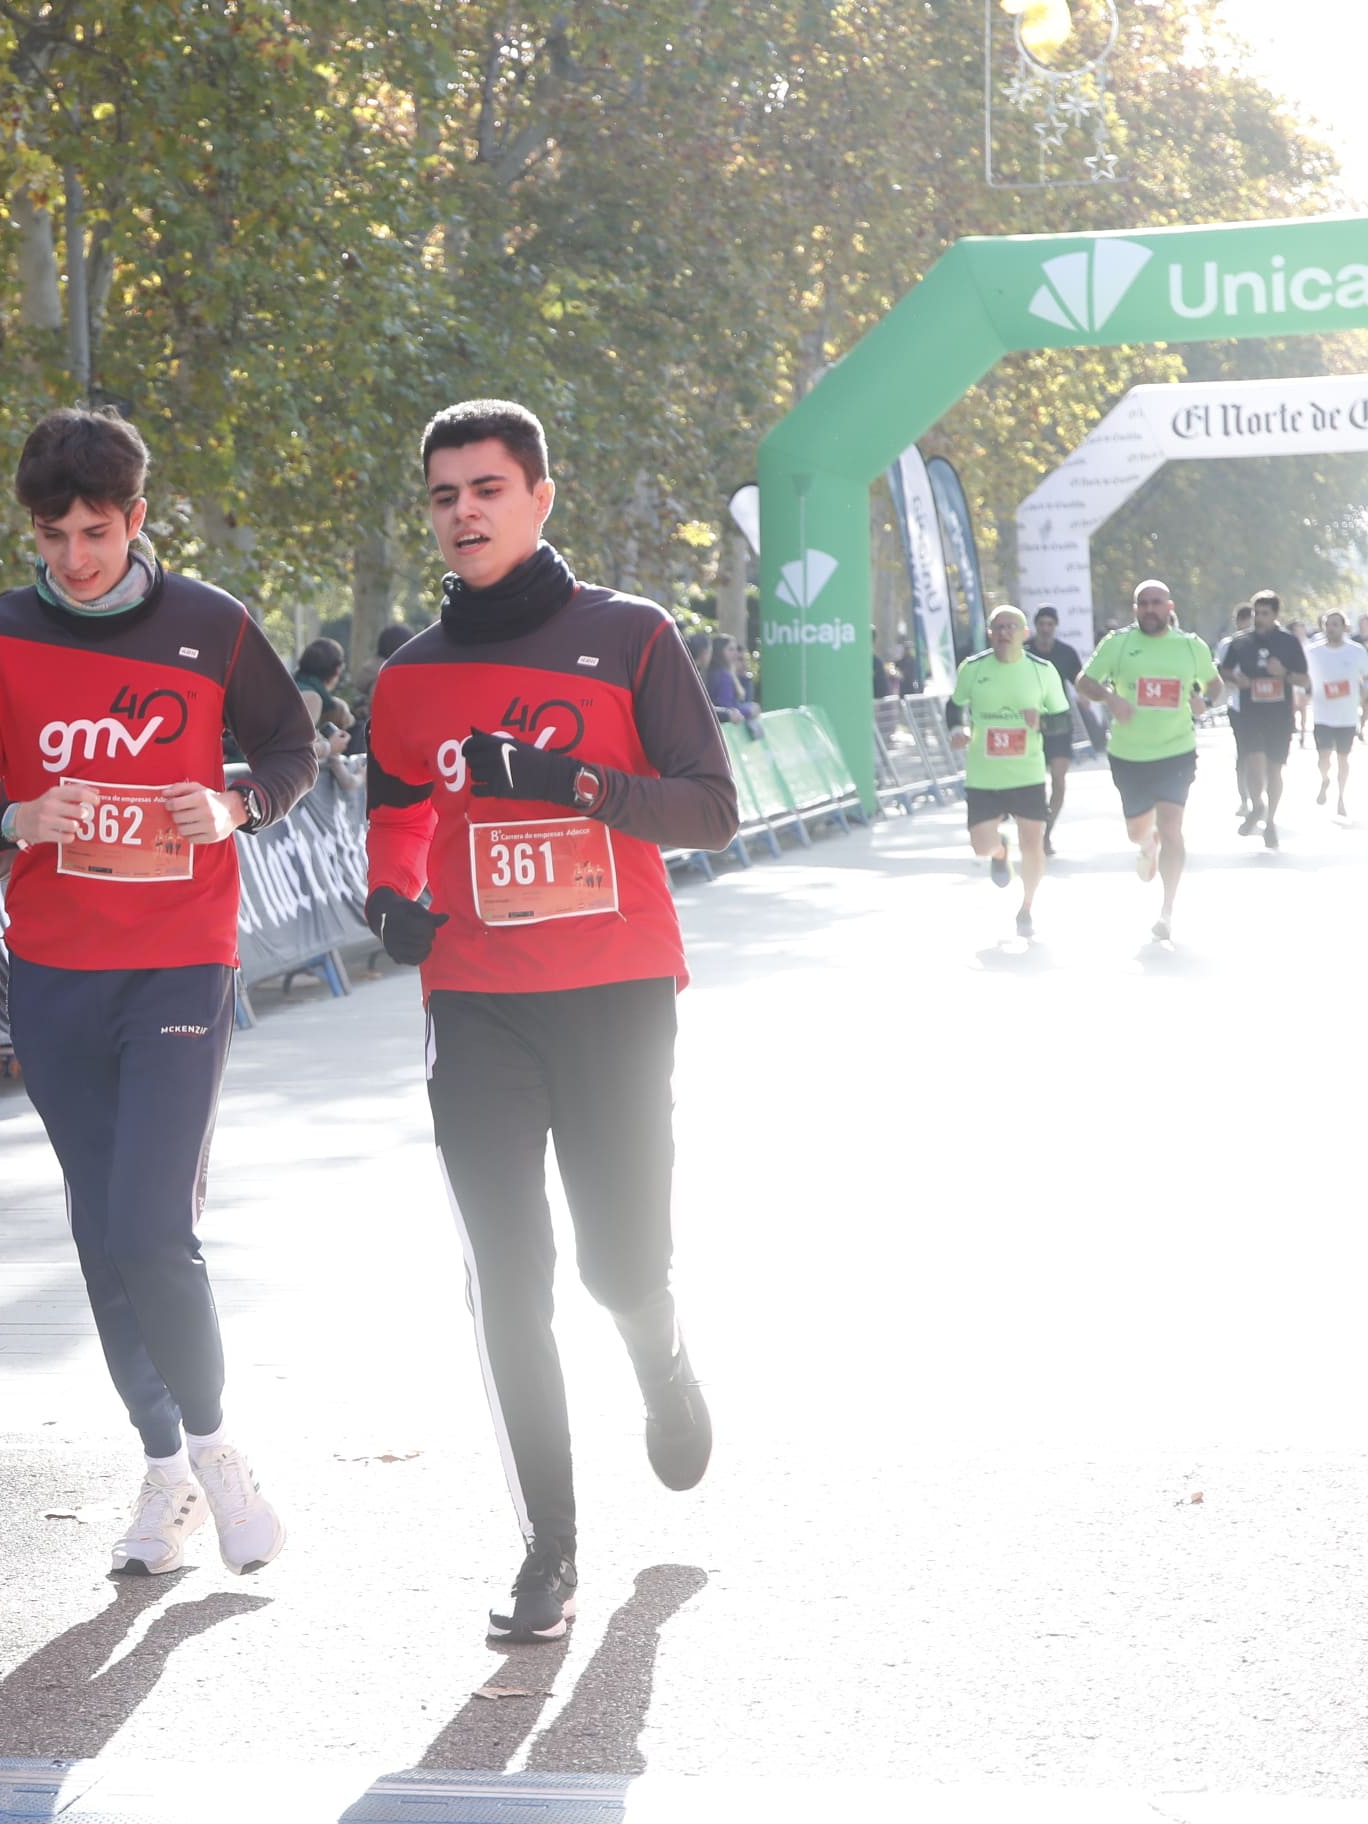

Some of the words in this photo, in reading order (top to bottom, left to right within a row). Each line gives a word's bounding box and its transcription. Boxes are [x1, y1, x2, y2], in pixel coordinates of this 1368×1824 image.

[1169, 254, 1368, 319] Unica
[1172, 403, 1211, 440] El
[1219, 401, 1303, 437] Norte
[1310, 402, 1342, 432] de
[763, 617, 857, 652] Unicaja
[1145, 682, 1162, 699] 54
[39, 716, 164, 773] gmv
[76, 802, 143, 845] 362
[490, 841, 555, 887] 361
